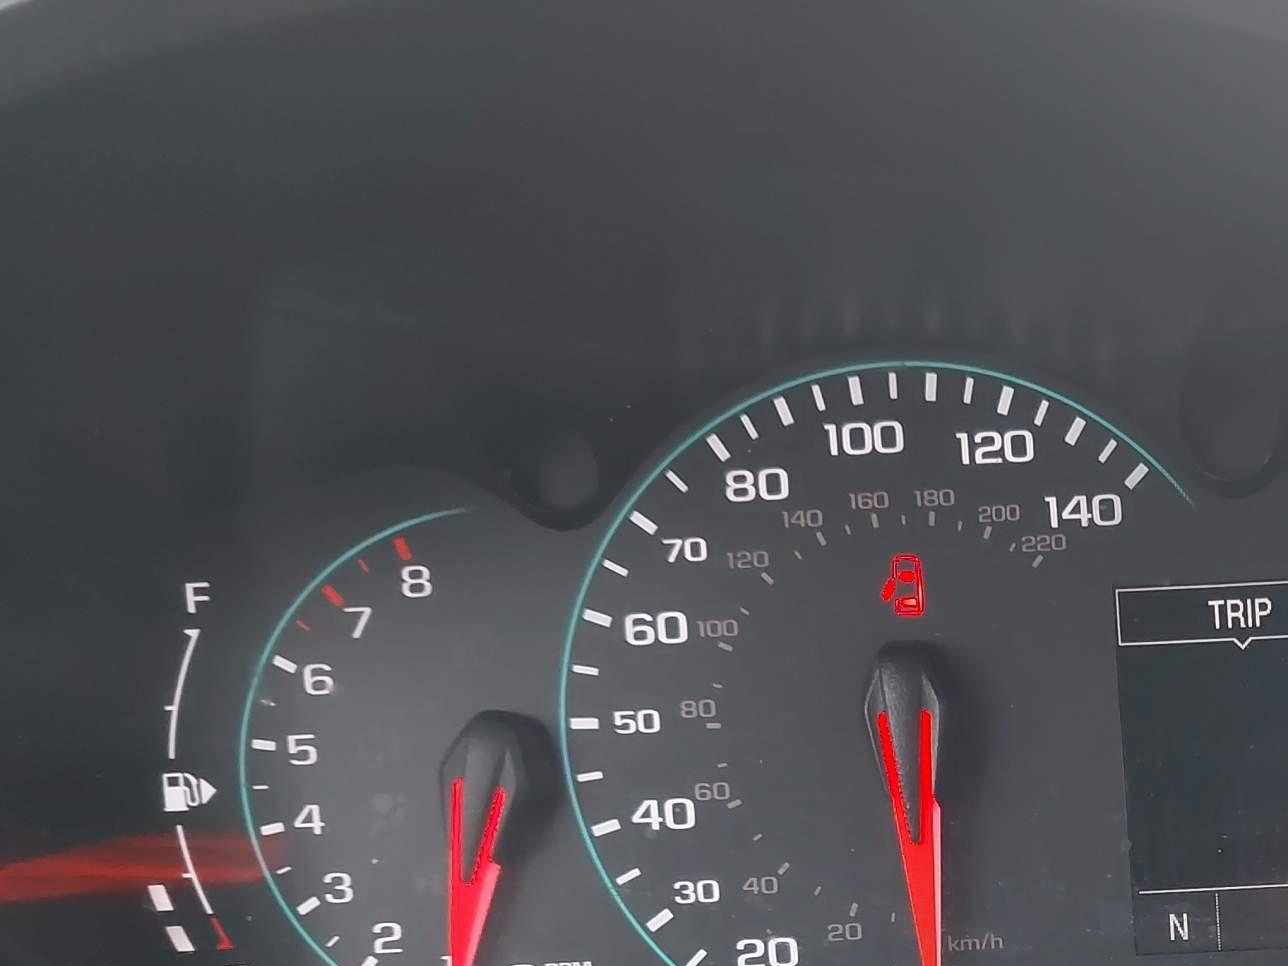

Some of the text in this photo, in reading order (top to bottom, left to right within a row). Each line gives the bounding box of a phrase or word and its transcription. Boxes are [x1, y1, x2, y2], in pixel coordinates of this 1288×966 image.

[824, 421, 904, 456] 100
[956, 429, 1034, 464] 120
[726, 468, 788, 501] 80
[914, 489, 955, 506] 180
[849, 492, 889, 510] 160
[979, 505, 1020, 523] 200
[1045, 494, 1122, 528] 140
[782, 509, 823, 528] 140
[662, 538, 707, 562] 70
[1022, 534, 1066, 552] 220
[727, 551, 769, 569] 120
[401, 566, 432, 597] 8
[185, 582, 210, 613] F
[343, 607, 372, 638] 7
[1208, 598, 1272, 630] TRIP
[624, 613, 688, 646] 60
[698, 620, 738, 637] 100
[303, 663, 335, 695] 6
[614, 709, 661, 734] 50
[680, 700, 716, 718] 80
[287, 734, 318, 766] 5
[695, 783, 730, 801] 60
[294, 804, 325, 834] 4
[632, 799, 696, 831] 40
[323, 873, 354, 903] 3
[673, 880, 720, 904] 30
[743, 876, 778, 895] 40
[372, 922, 403, 954] 2
[827, 922, 862, 941] 20
[1169, 913, 1189, 941] N
[948, 932, 1004, 951] km/h
